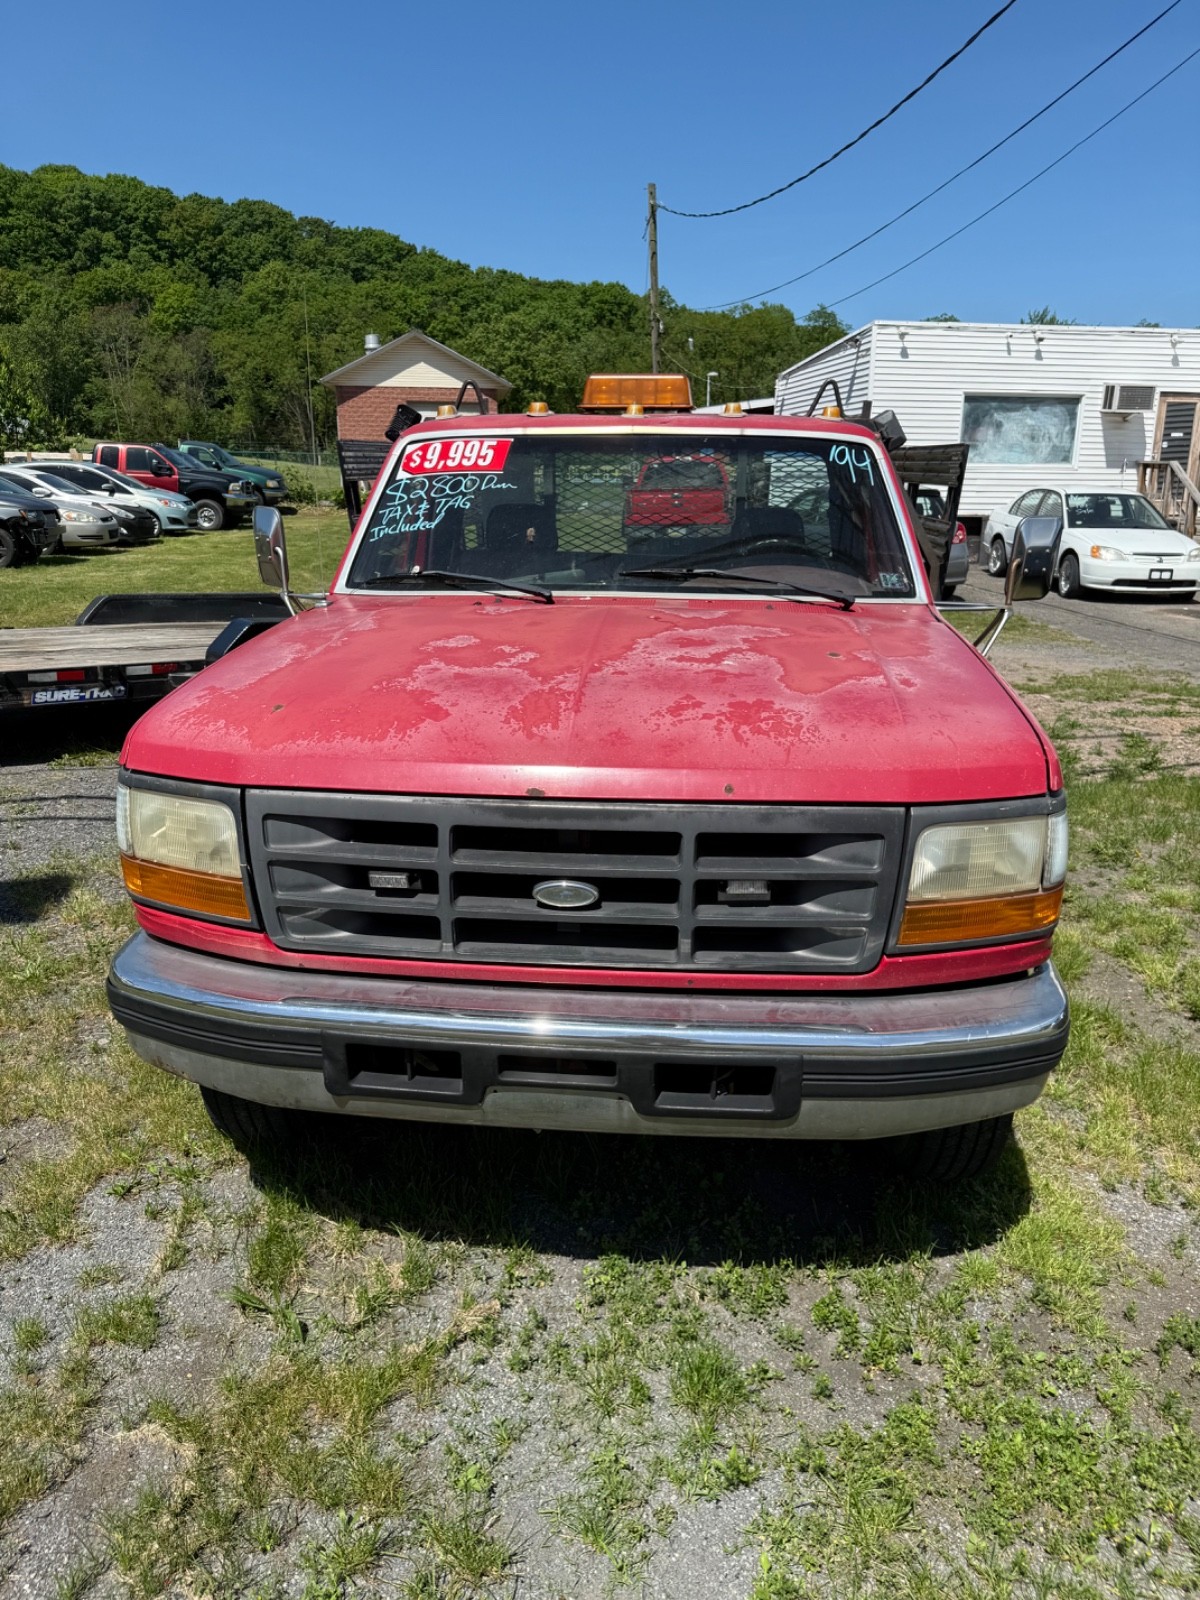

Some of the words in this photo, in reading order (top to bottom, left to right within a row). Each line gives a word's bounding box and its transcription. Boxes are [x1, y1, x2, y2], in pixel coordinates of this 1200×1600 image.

[409, 440, 498, 470] $9,995
[386, 474, 480, 506] $2800
[379, 503, 413, 526] TAX
[435, 495, 475, 515] TAG
[369, 511, 445, 542] Included
